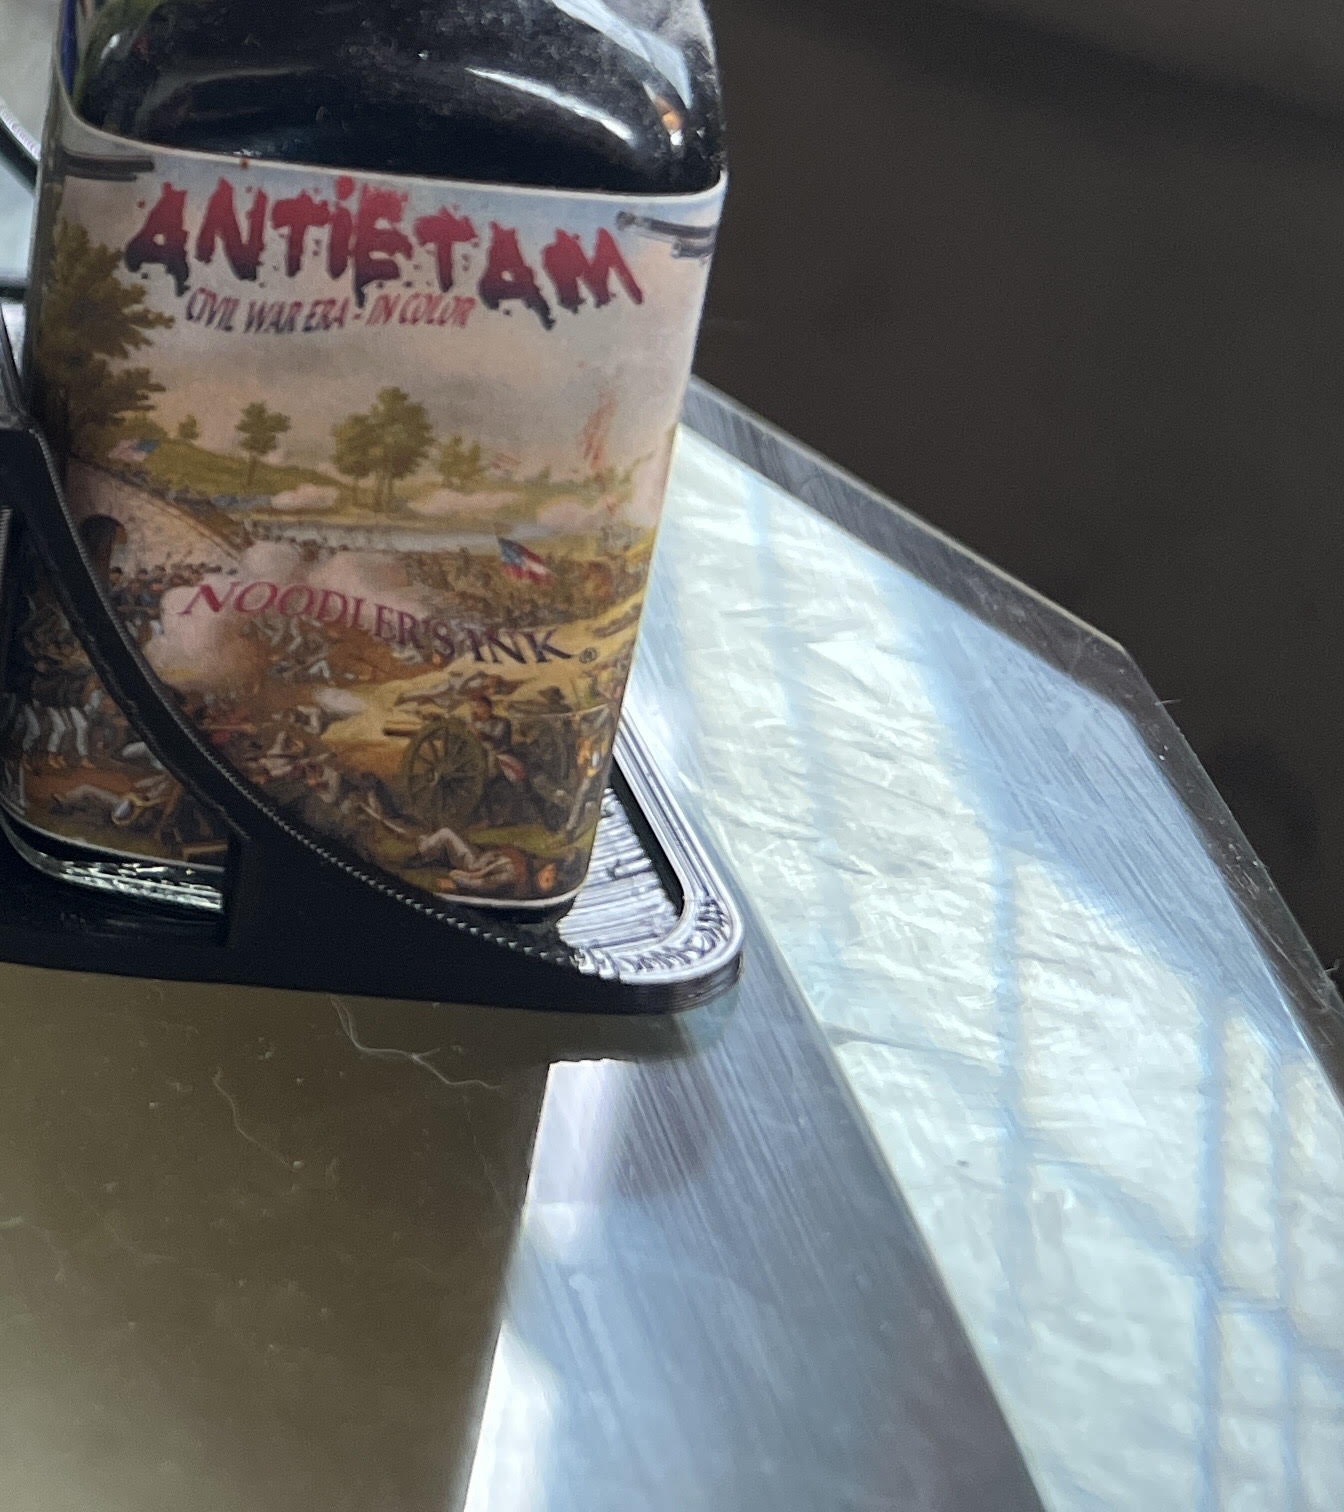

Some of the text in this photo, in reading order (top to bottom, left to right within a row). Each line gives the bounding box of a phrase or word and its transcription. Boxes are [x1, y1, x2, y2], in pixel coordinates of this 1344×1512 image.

[186, 287, 240, 332] CIVIL
[242, 299, 303, 335] WAR
[302, 297, 350, 333] ERA
[365, 293, 400, 327] IN
[398, 292, 477, 328] COLOR
[178, 581, 457, 660] NOODLER'S
